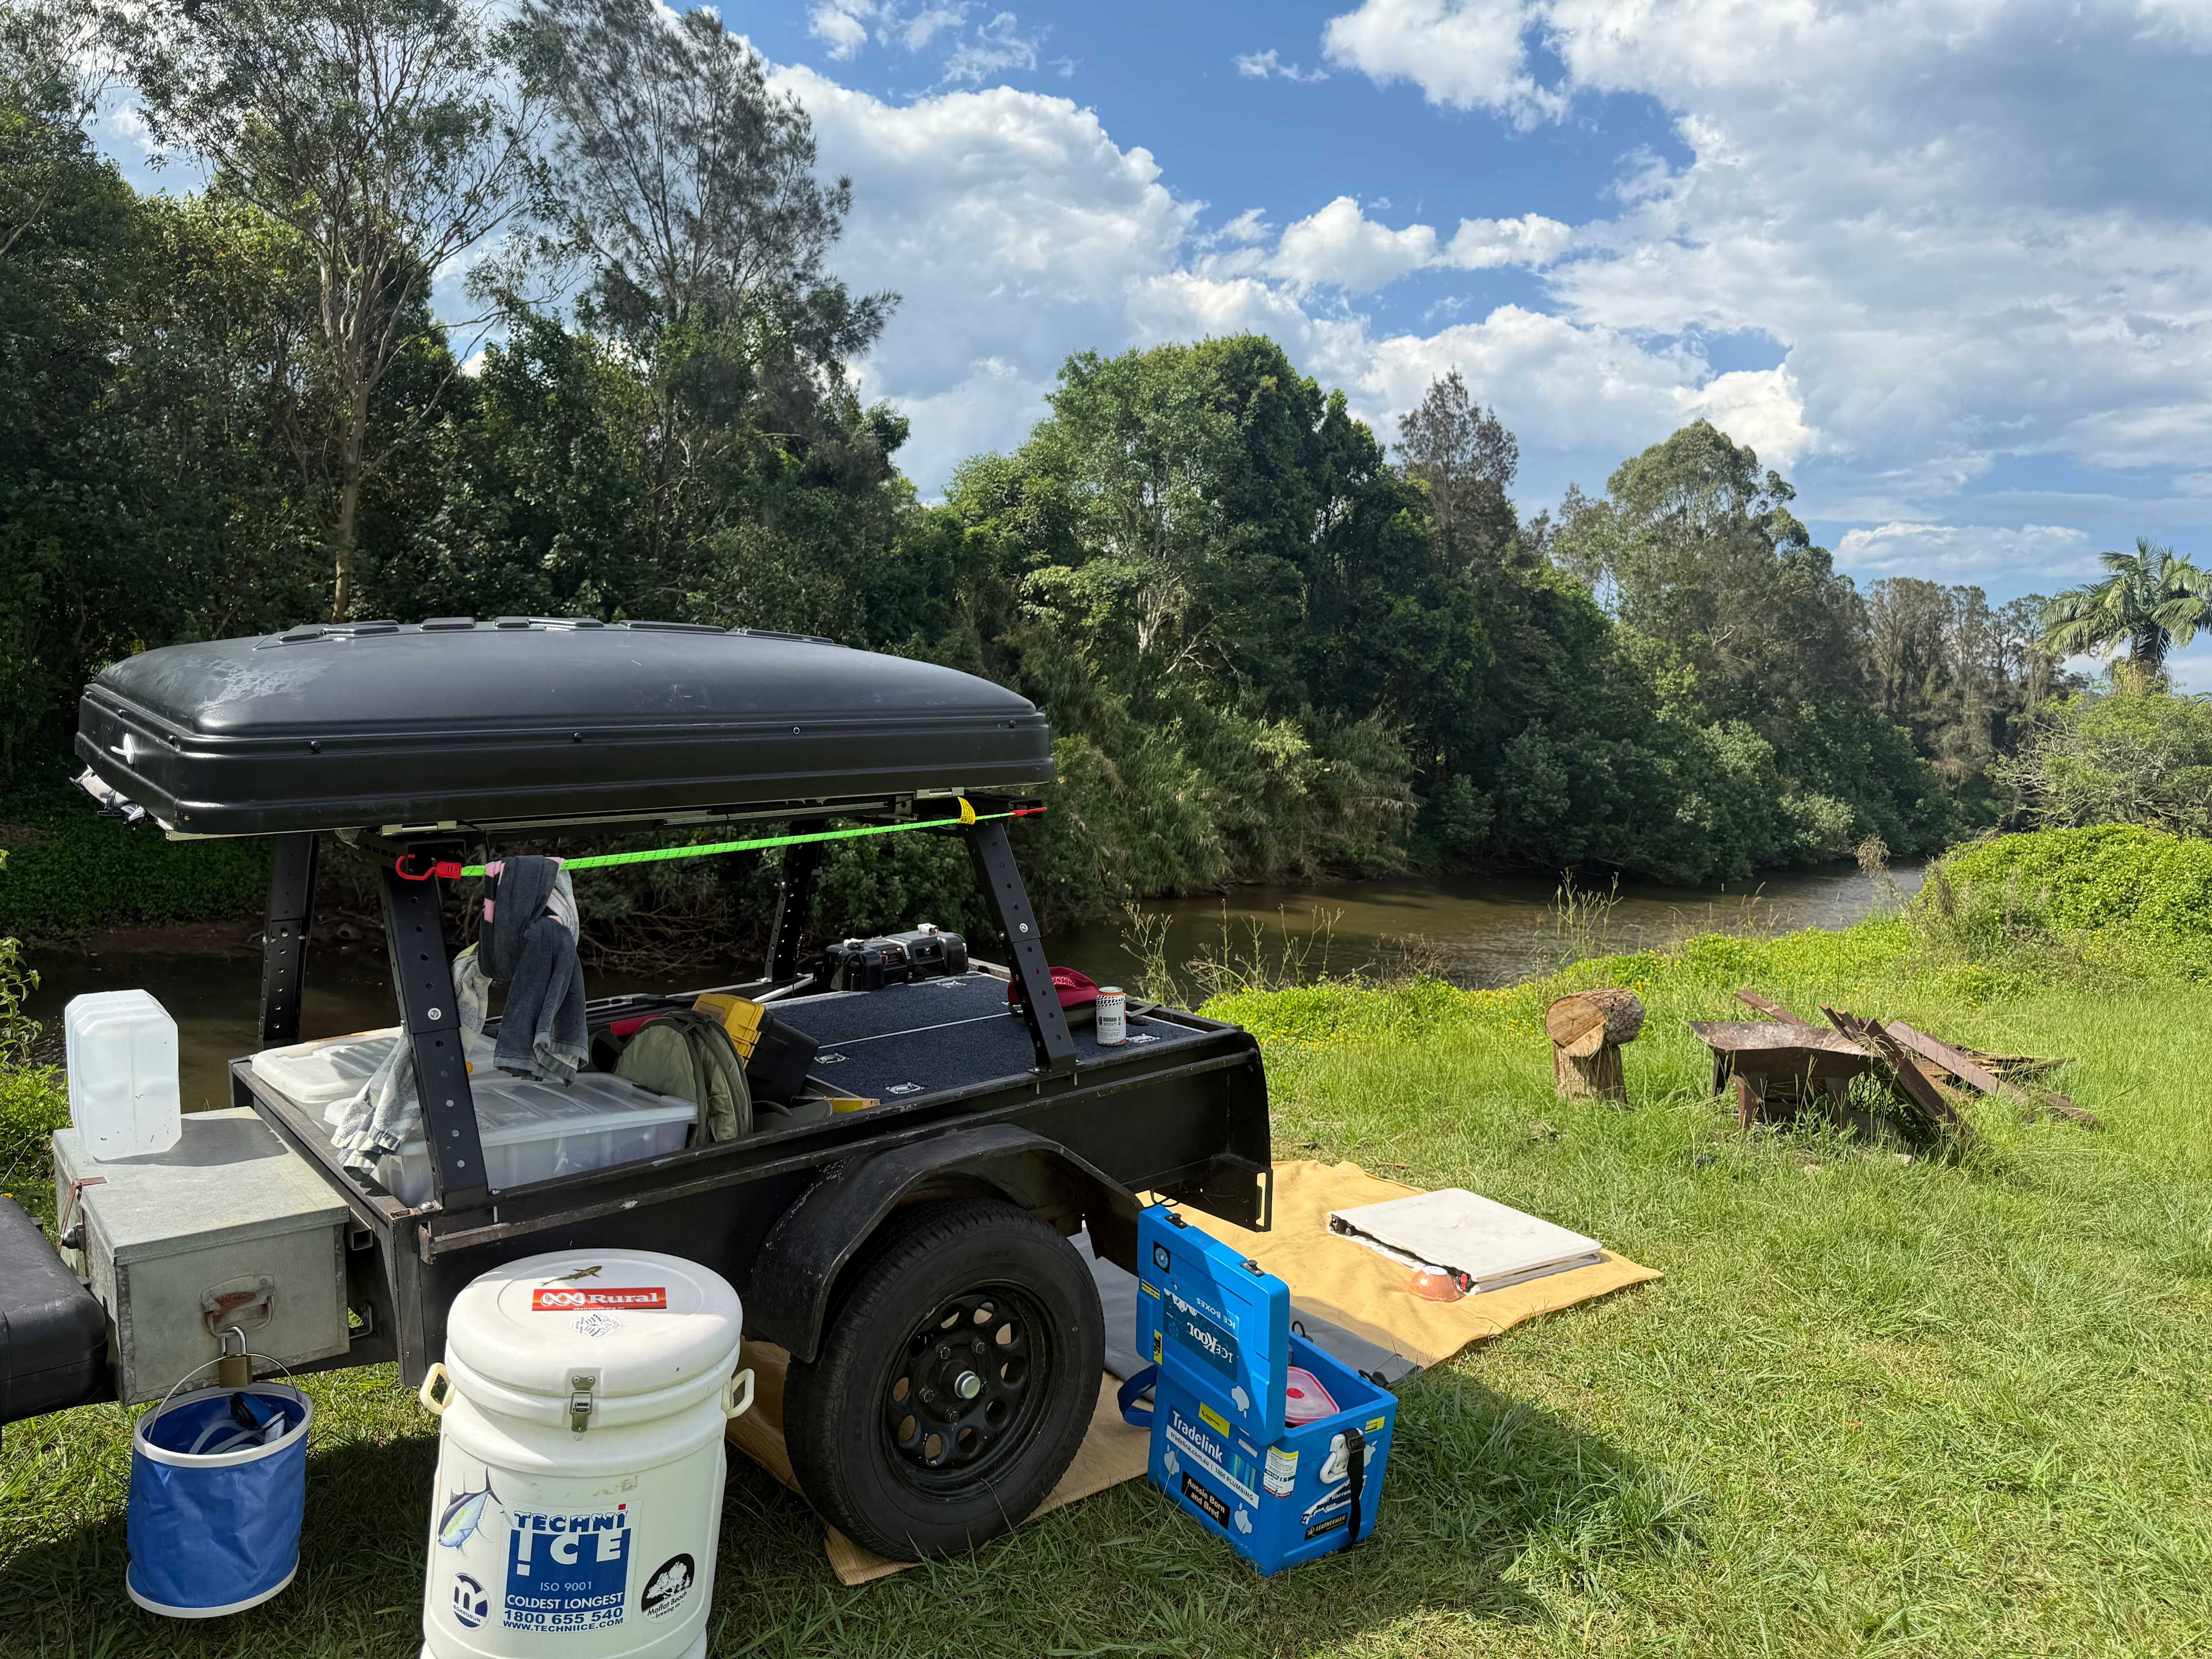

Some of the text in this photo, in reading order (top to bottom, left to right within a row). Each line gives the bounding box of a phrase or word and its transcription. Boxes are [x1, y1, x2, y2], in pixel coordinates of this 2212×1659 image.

[588, 1293, 659, 1304] Rural
[1196, 1297, 1236, 1330] ICE BOXES
[1172, 1410, 1224, 1464] Tradelink
[1171, 1432, 1209, 1466] tradelink.com.au
[1215, 1467, 1226, 1479] 1800
[1226, 1476, 1253, 1501] PLUMBING
[1187, 1478, 1225, 1513] Aussie Born
[1191, 1491, 1202, 1505] and
[514, 1503, 628, 1533] TECHNI
[1316, 1514, 1346, 1531] LEATHERMAN
[540, 1581, 592, 1592] ISO 9001
[506, 1592, 623, 1609] COLDEST LONGEST
[647, 1590, 687, 1616] Moffat Beach
[505, 1607, 623, 1624] 1800 655 540
[656, 1606, 674, 1618] brewing
[503, 1617, 623, 1633] WWW.TECHNIICE.COM
